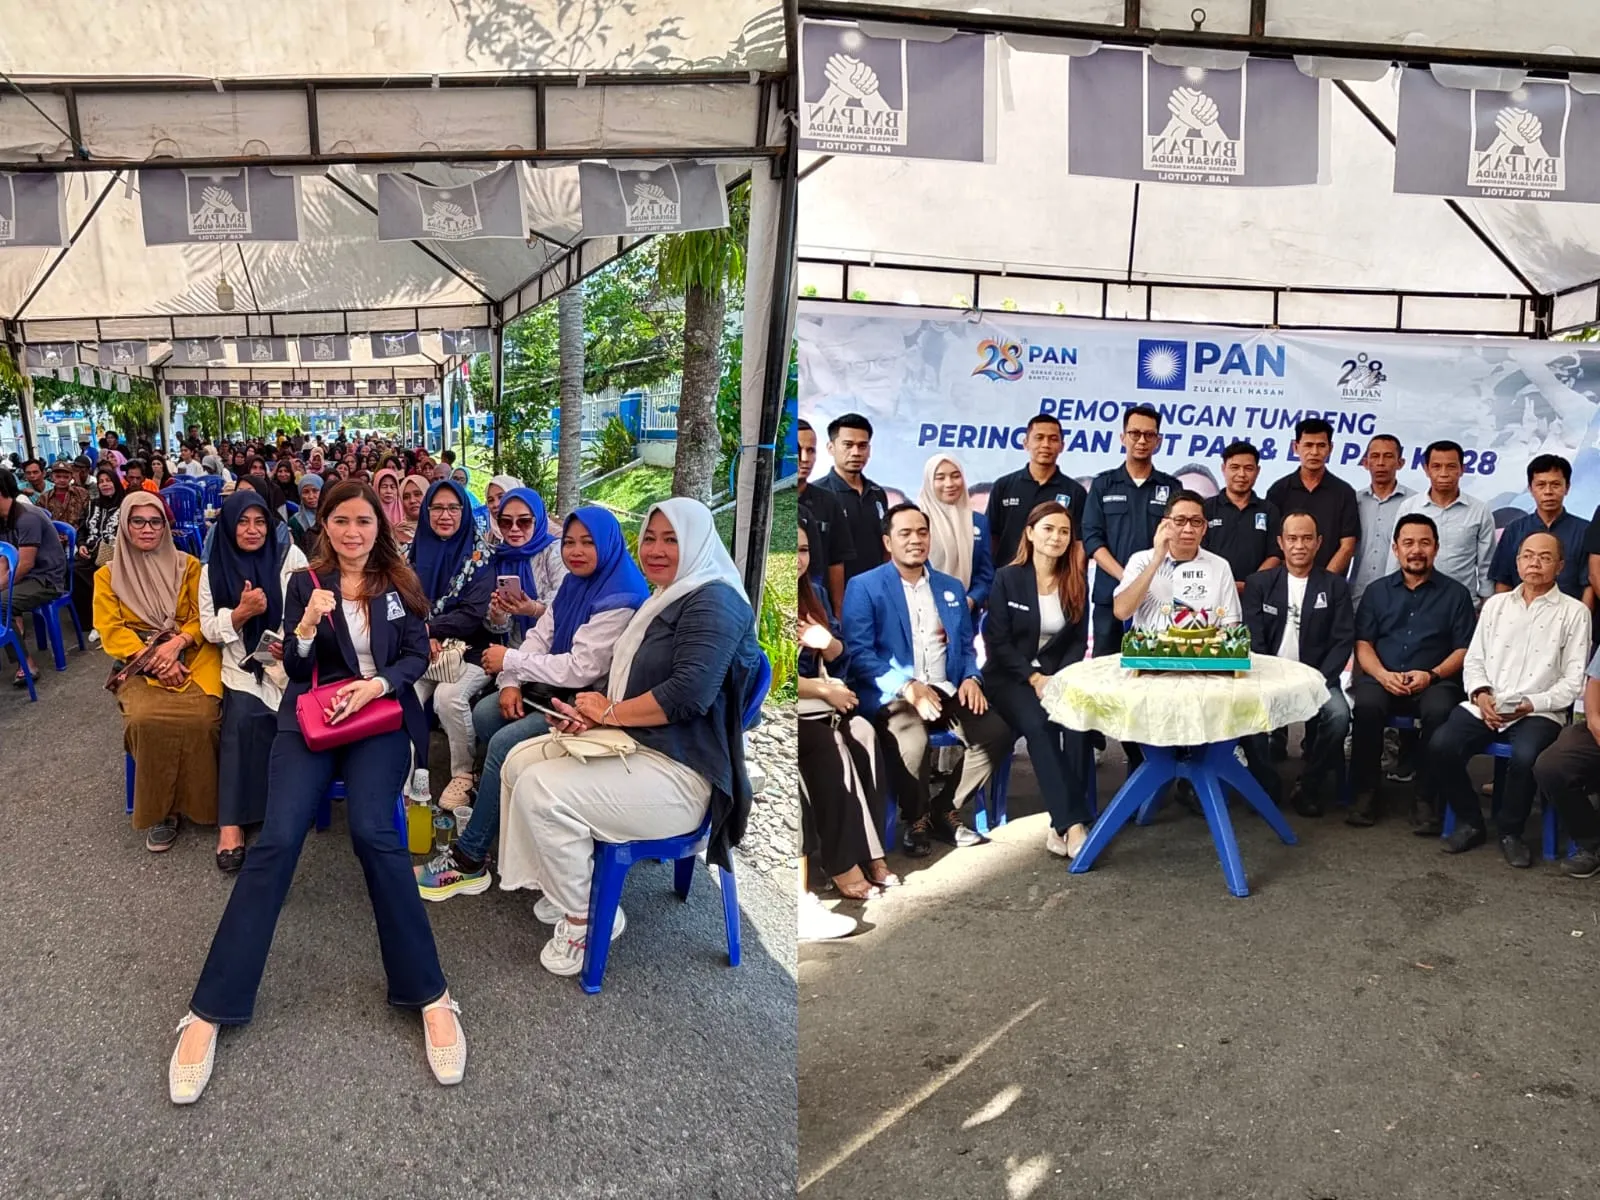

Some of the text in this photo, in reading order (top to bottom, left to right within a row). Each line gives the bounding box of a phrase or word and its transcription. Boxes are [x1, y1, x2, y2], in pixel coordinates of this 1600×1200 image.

[1029, 346, 1077, 364] PAN
[1194, 342, 1285, 377] PAN
[1193, 385, 1284, 396] ZULKIFLI HASAN
[1360, 388, 1383, 398] PAN
[1258, 437, 1278, 460] &
[439, 875, 465, 887] HOKA
